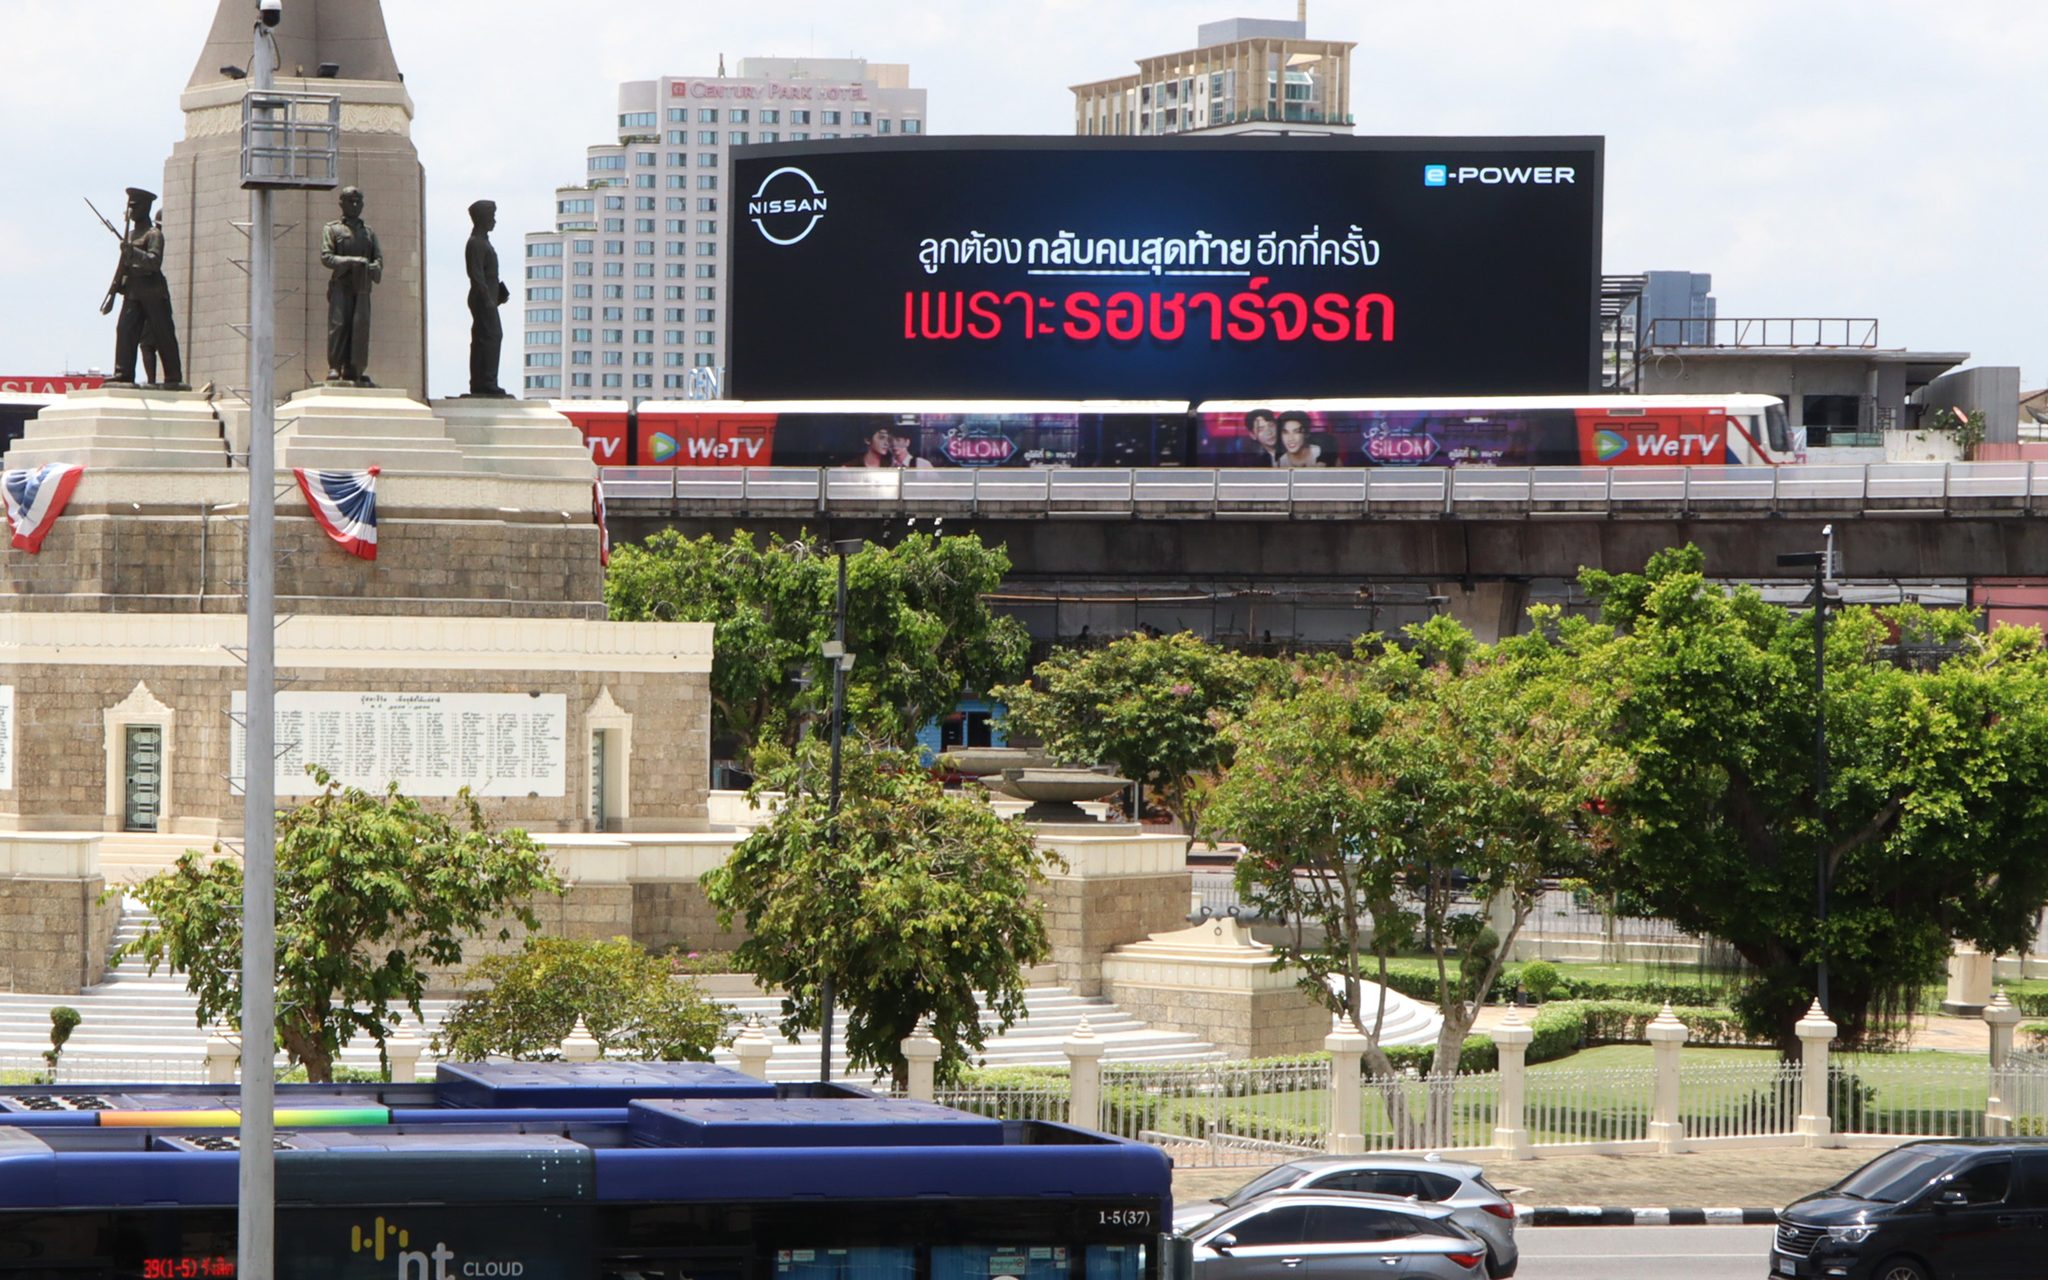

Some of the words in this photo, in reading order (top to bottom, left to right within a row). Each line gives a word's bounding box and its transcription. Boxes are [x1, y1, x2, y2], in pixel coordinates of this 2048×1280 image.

[690, 82, 765, 100] CENTURY
[768, 83, 812, 100] PARK
[1426, 167, 1576, 184] e-POWER
[748, 198, 827, 215] NISSAN
[918, 230, 1022, 274] ลูกต้อง
[1027, 229, 1251, 276] กลับคนสุดท้าย
[1256, 224, 1380, 266] อีกกี่ครั้ง
[687, 437, 764, 459] WeTV
[948, 440, 1009, 458] SILOM
[1370, 439, 1431, 457] SILOM
[1636, 434, 1720, 456] WeTV
[1099, 1210, 1151, 1227] 1-5(37)
[143, 1258, 198, 1278] 39(1-5)
[463, 1262, 523, 1276] CLOUD
